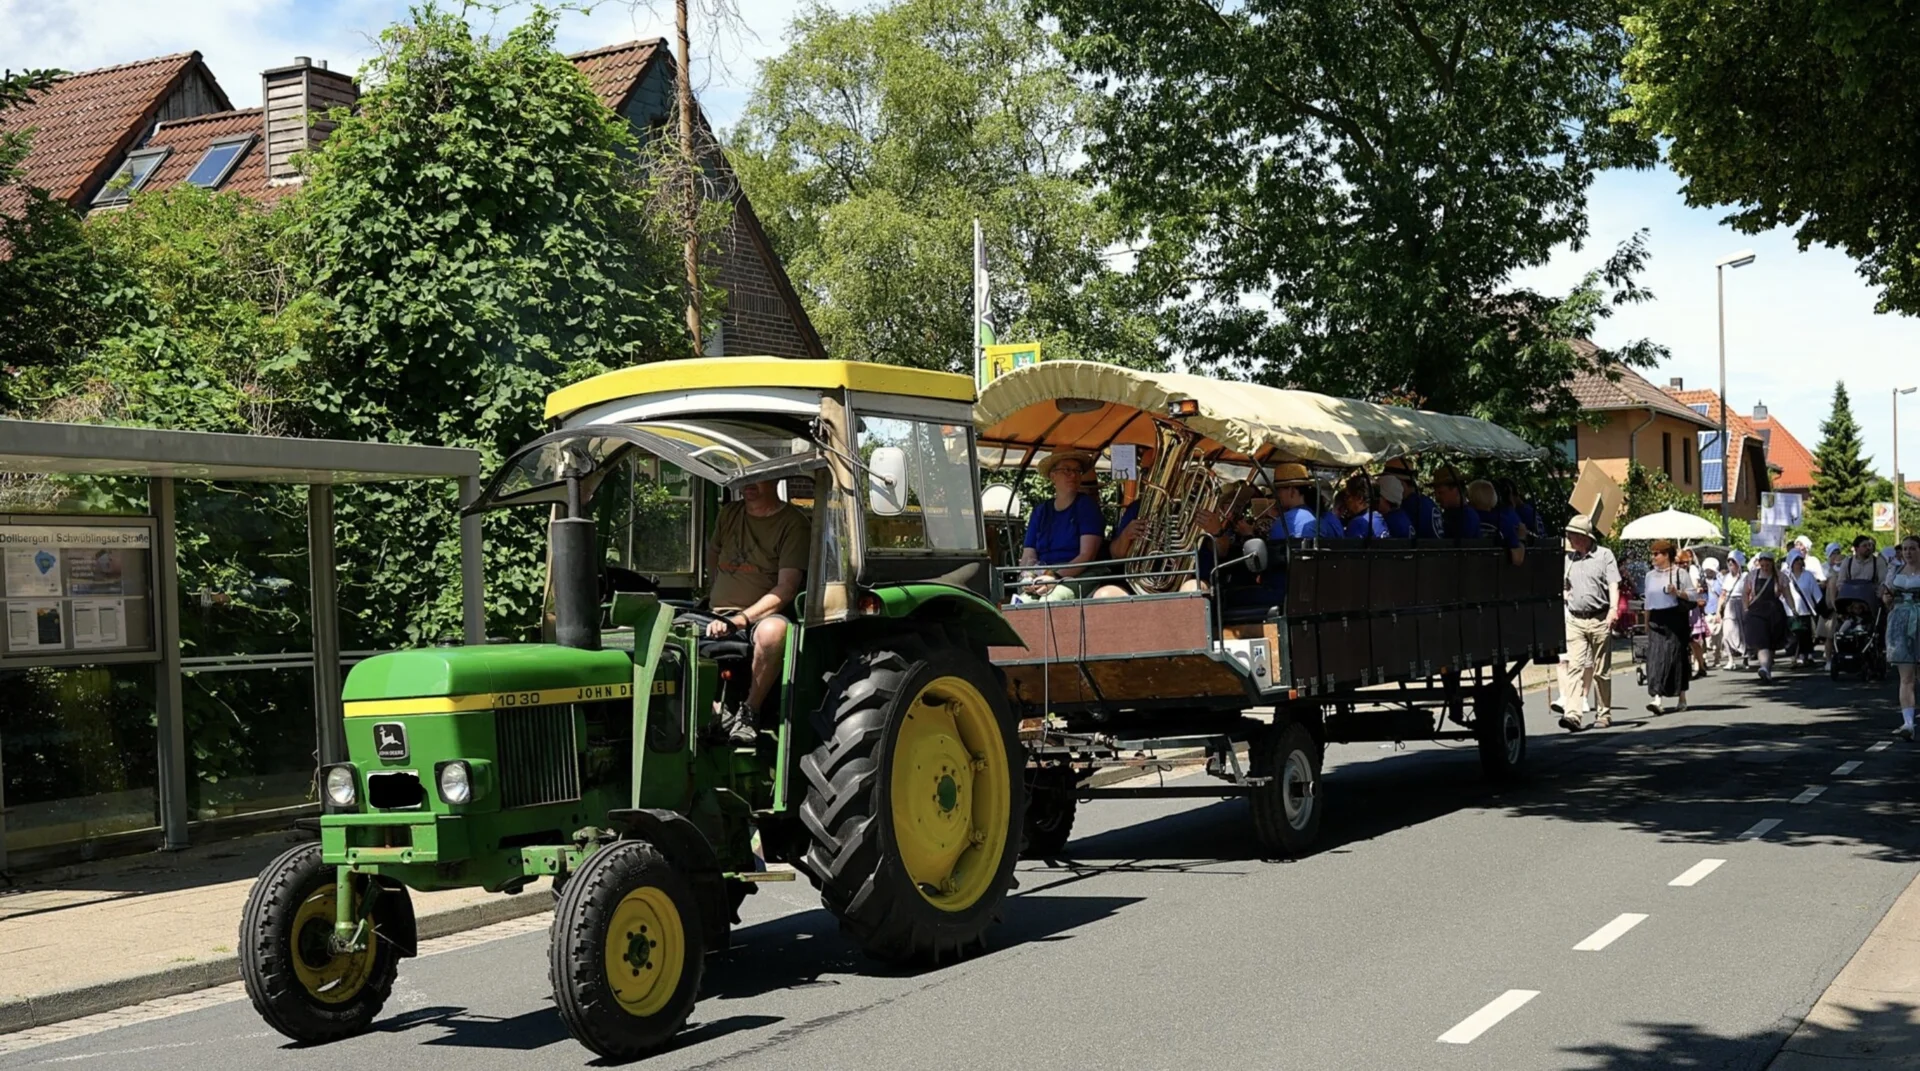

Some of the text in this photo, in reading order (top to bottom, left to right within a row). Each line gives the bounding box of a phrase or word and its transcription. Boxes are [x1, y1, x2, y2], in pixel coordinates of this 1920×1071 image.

[0, 533, 49, 545] Dollbergen
[56, 532, 120, 546] Schwüblingser
[122, 533, 149, 544] Straße
[577, 681, 663, 700] JOHN DEE
